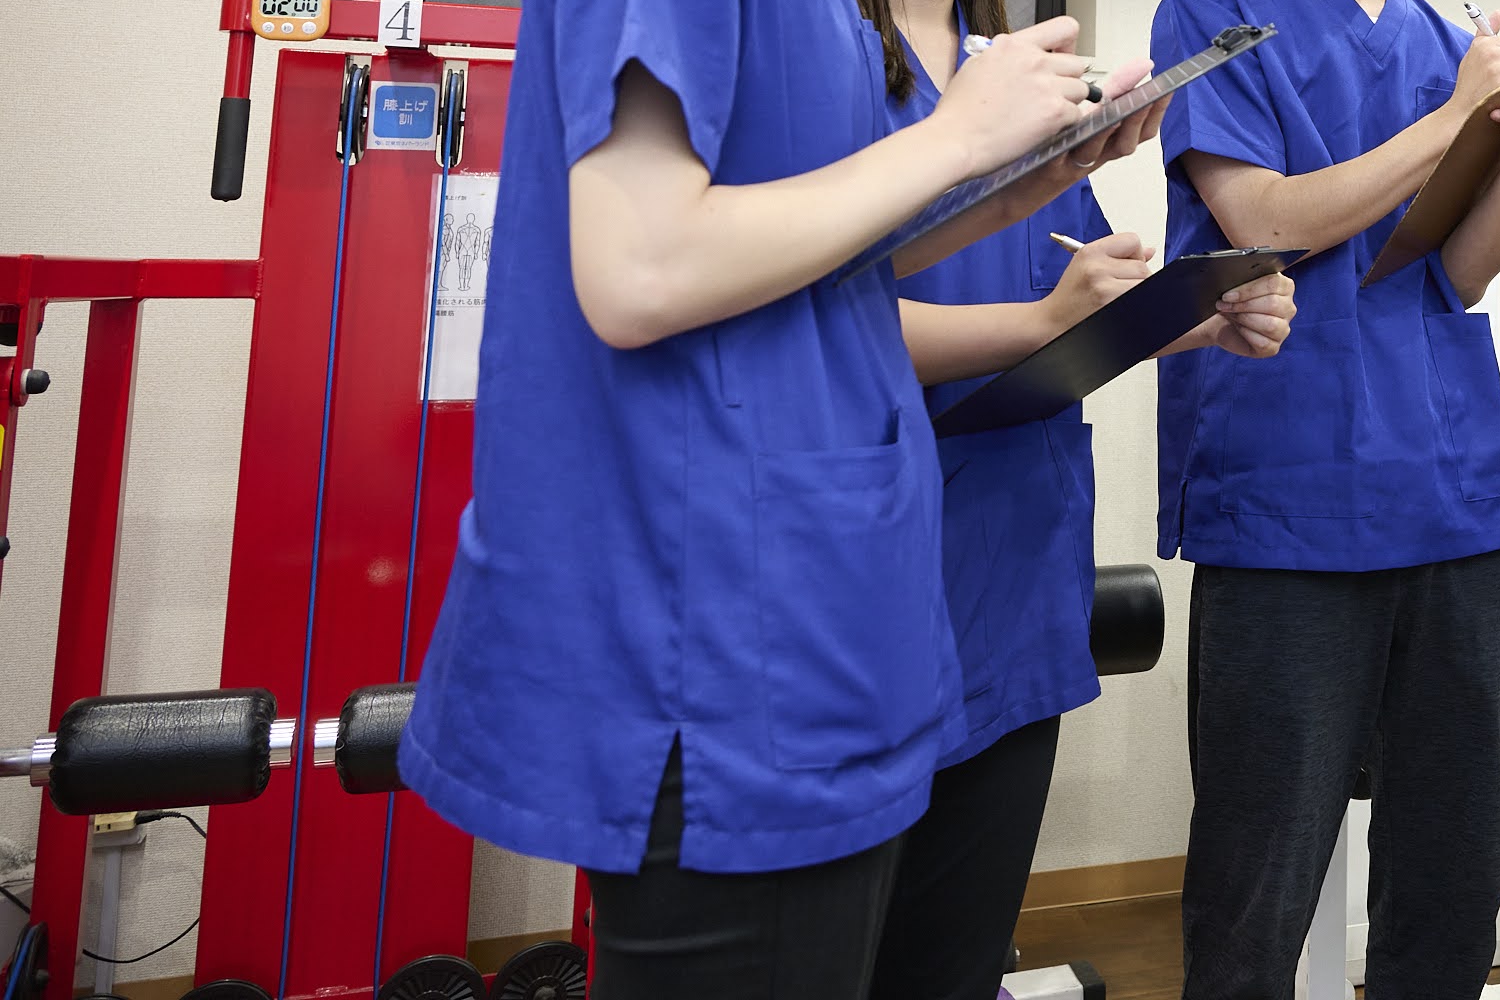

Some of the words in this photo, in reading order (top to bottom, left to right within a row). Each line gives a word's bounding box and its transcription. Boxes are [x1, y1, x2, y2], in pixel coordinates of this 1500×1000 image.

[385, 0, 415, 40] 4
[383, 99, 428, 112] 膝上げ
[399, 113, 413, 125] 訓
